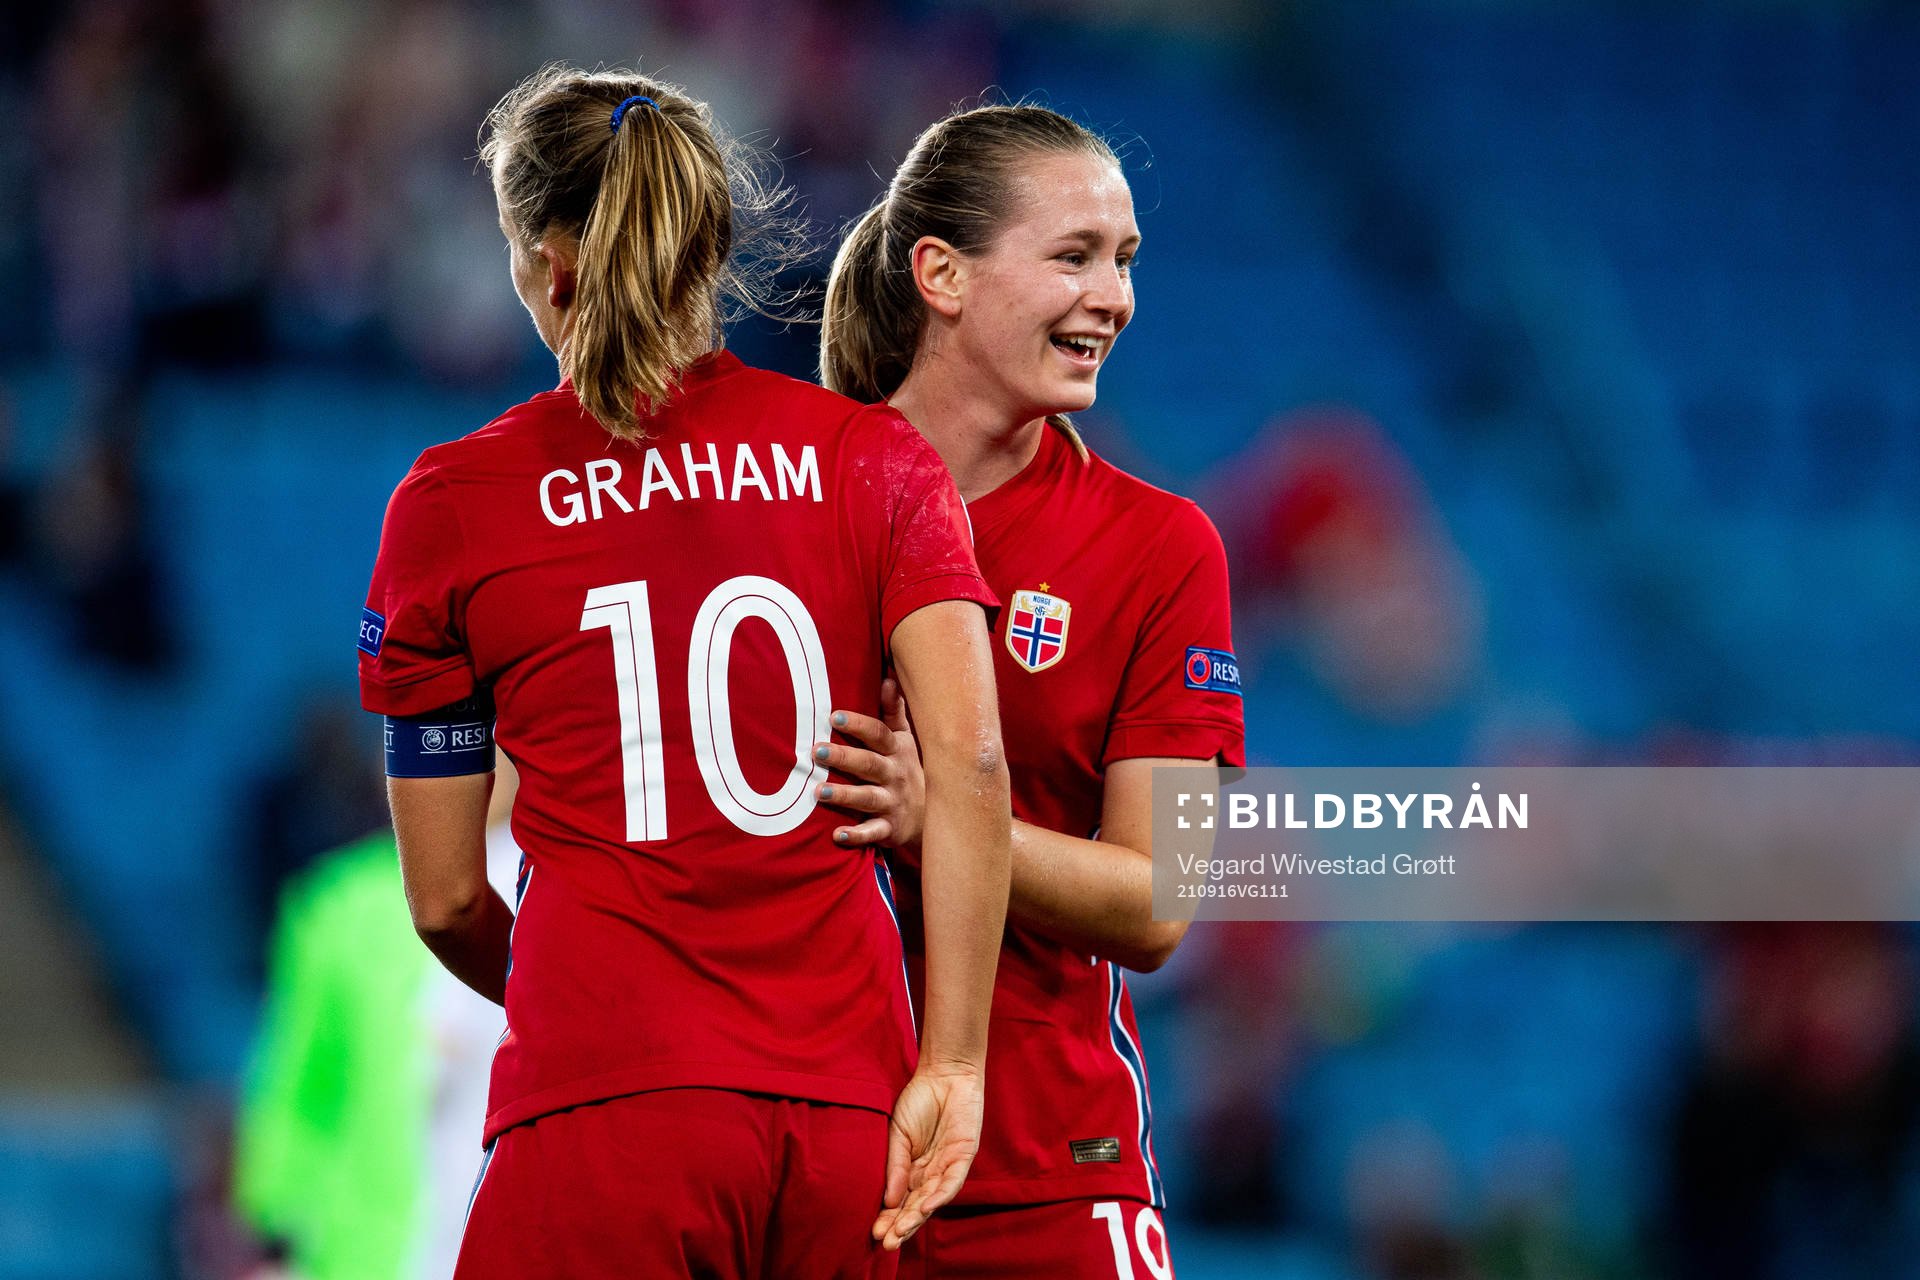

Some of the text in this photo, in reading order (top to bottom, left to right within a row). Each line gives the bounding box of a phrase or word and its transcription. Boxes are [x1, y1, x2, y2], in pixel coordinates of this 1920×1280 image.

[538, 442, 824, 528] GRAHAM
[1032, 595, 1052, 604] NORGE
[359, 619, 383, 645] ECT
[578, 574, 833, 843] 10
